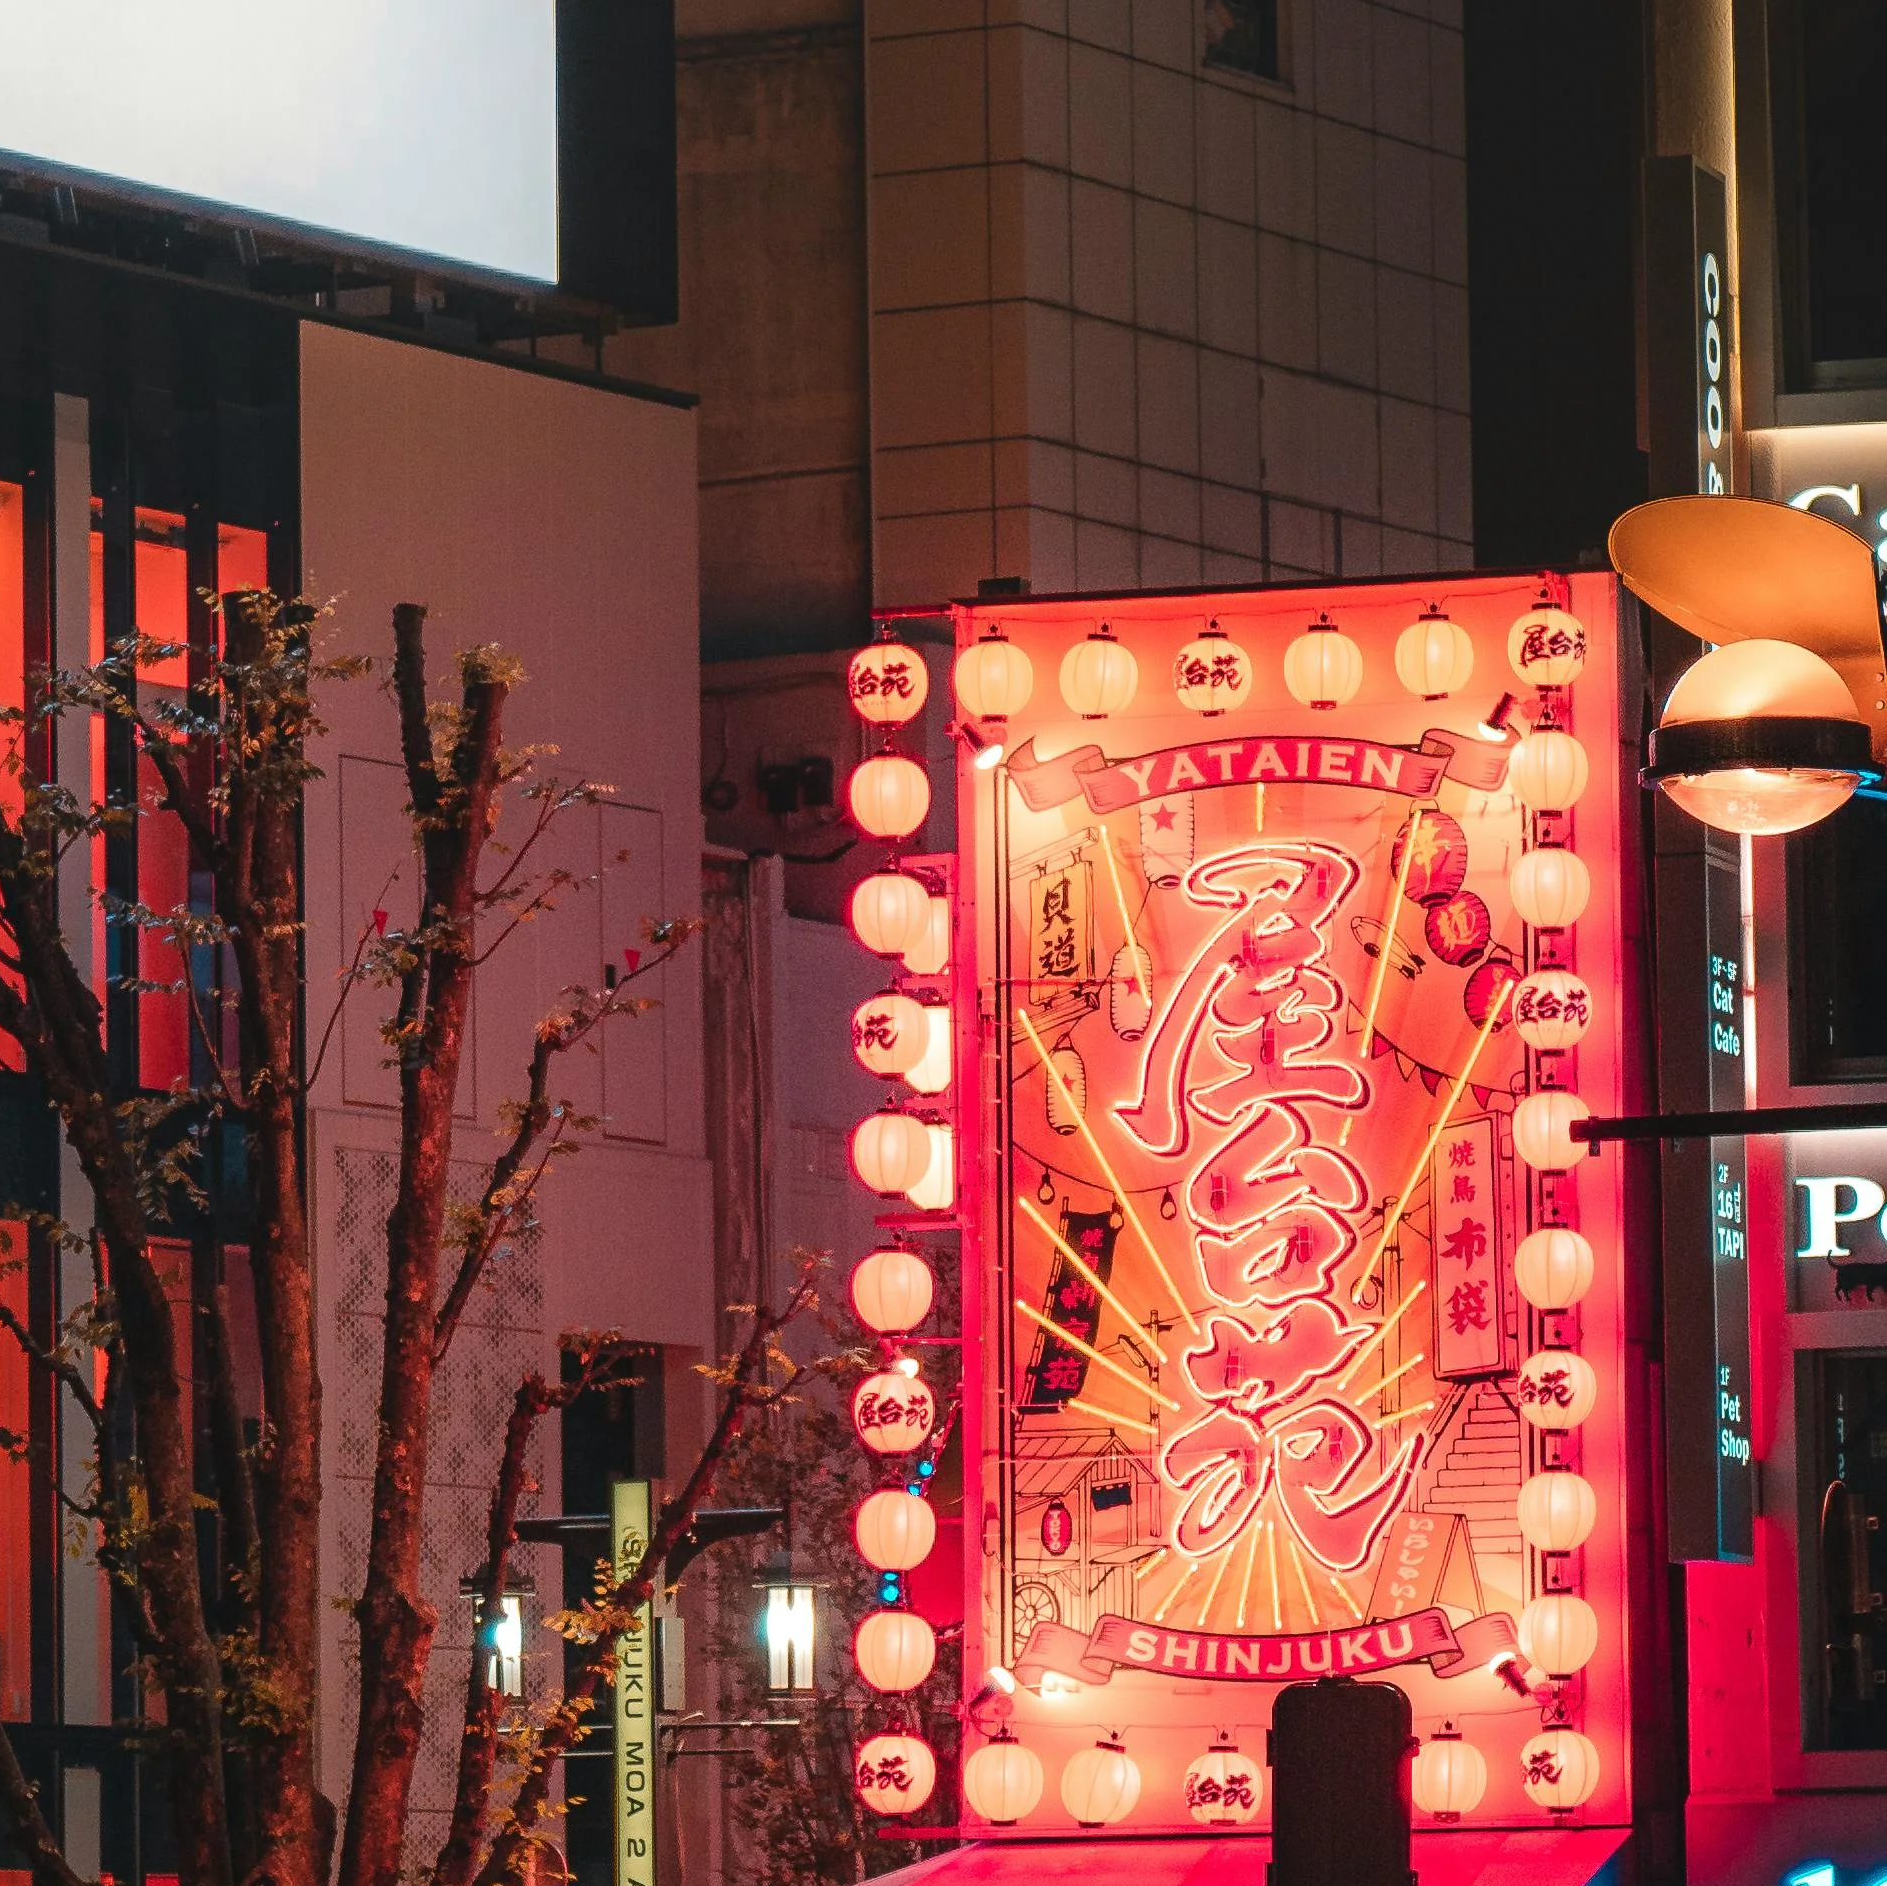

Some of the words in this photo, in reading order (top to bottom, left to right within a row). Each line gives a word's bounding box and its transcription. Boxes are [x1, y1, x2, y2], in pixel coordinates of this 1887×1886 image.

[1119, 741, 1405, 798] YATAIEN
[1713, 980, 1734, 1015] Cat
[1714, 1022, 1741, 1057] Cafe
[1795, 1176, 1887, 1259] P
[1717, 1227, 1745, 1261] TAPI
[1720, 1391, 1741, 1423] Pet
[1721, 1428, 1751, 1467] Shop
[1126, 1623, 1415, 1677] SHINJUKU
[625, 1742, 646, 1819] MOA
[626, 1838, 646, 1859] 2
